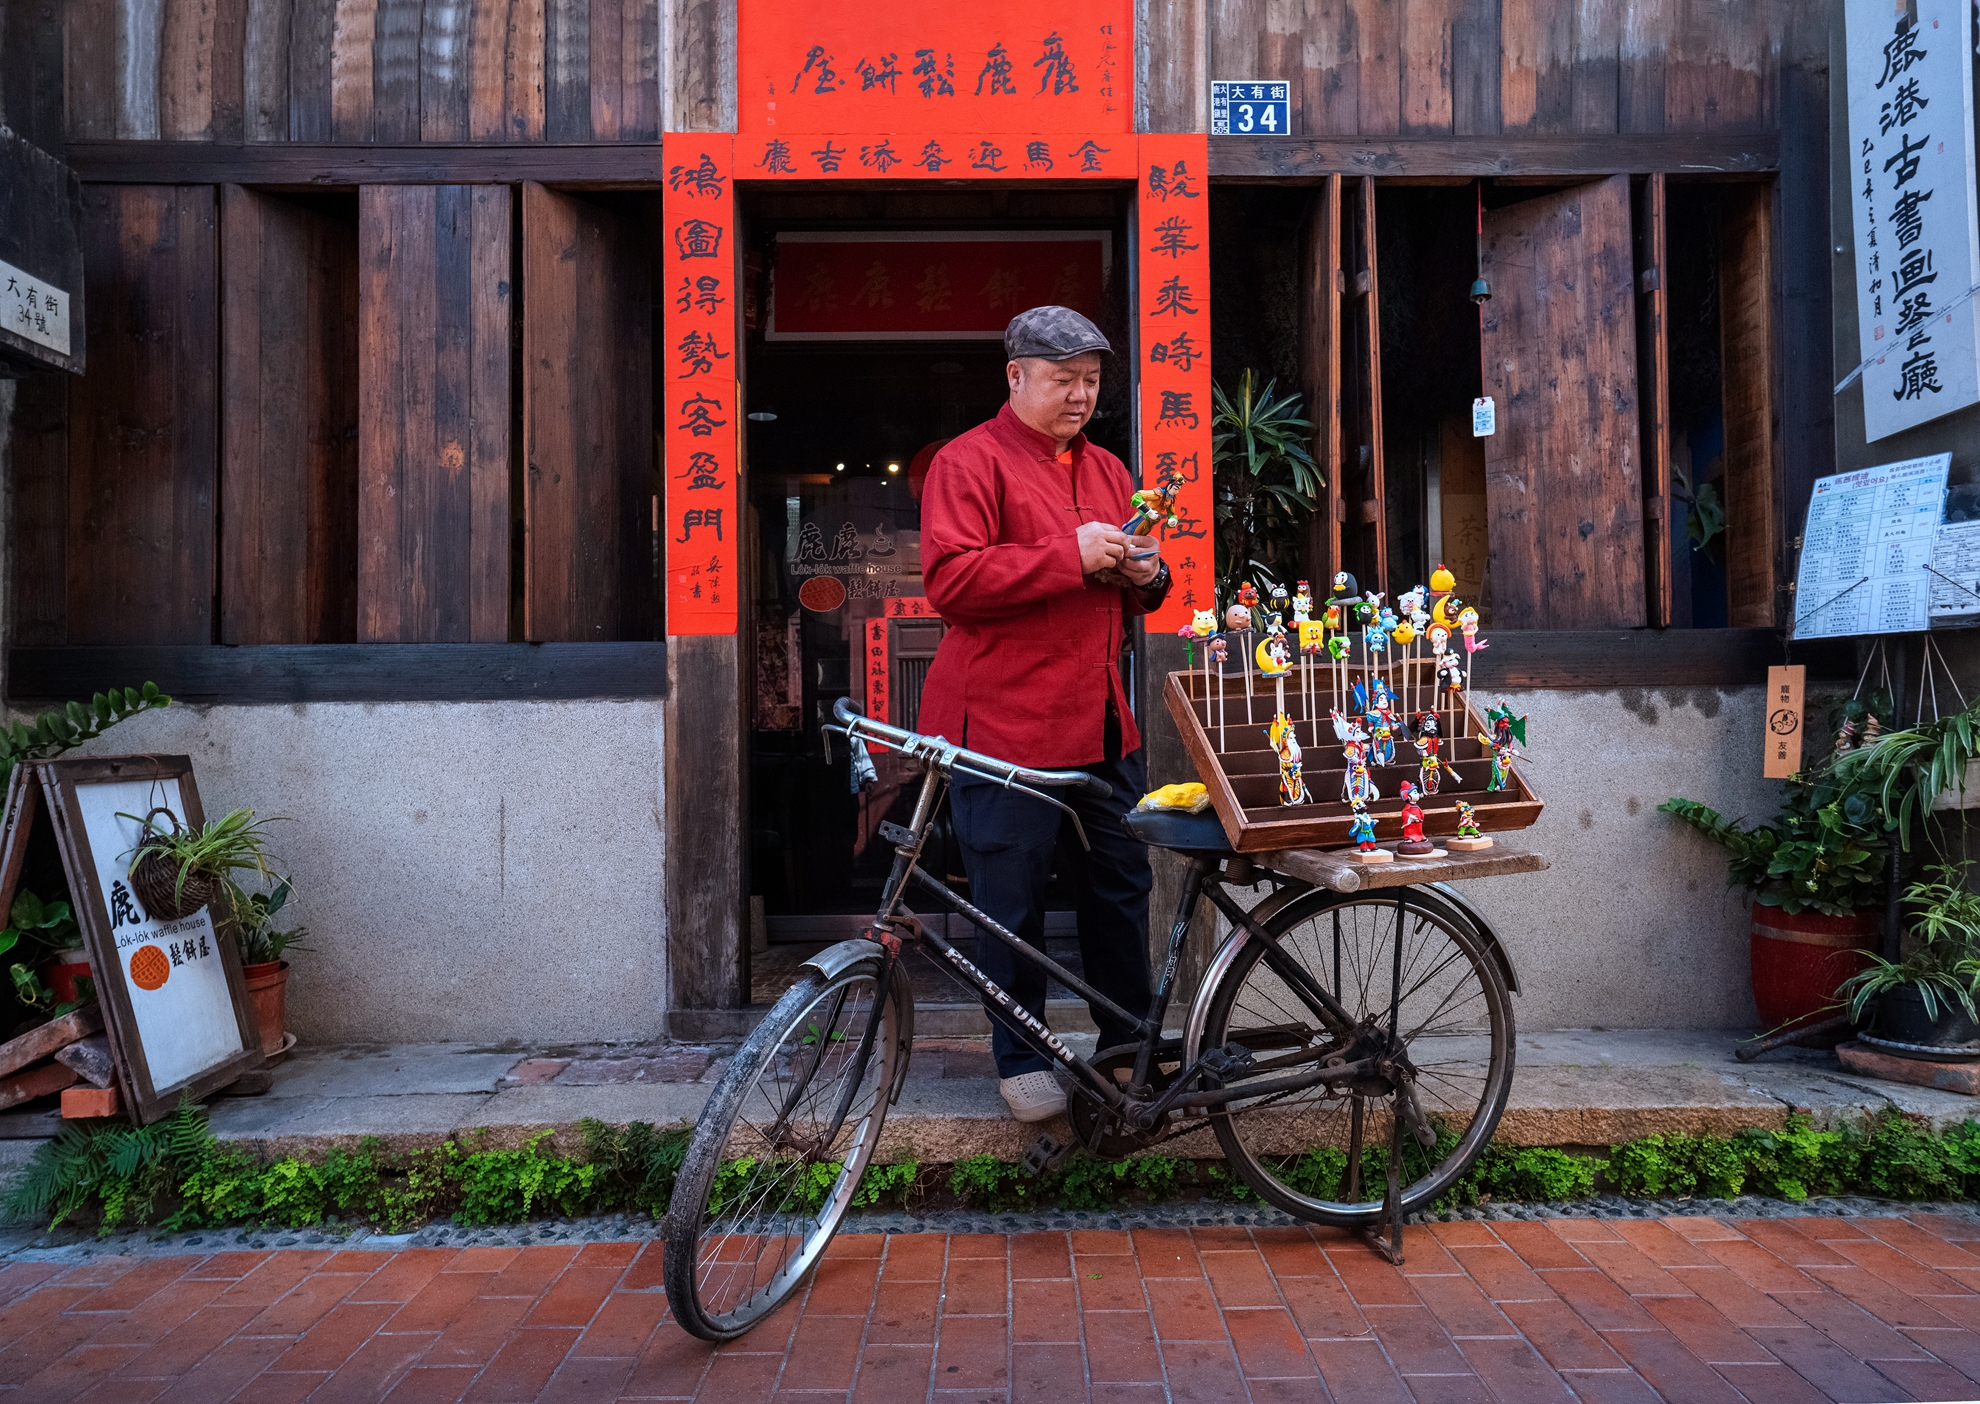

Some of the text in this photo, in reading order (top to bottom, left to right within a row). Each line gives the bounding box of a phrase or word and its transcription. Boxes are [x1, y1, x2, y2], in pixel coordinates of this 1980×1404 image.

[1231, 85, 1285, 99] 大有街
[1238, 104, 1278, 132] 34
[7, 276, 58, 316] 大有街
[18, 304, 50, 335] 34號
[668, 153, 730, 544] 鴻圖得勢客盈門
[1451, 513, 1483, 586] 茶道
[833, 564, 866, 575] waffle
[867, 563, 902, 575] house
[848, 579, 900, 599] 鬆餅屋
[151, 924, 179, 940] waffle
[179, 918, 206, 933] house
[169, 935, 211, 967] 鬆餅屋
[1013, 1004, 1076, 1062] UNION
